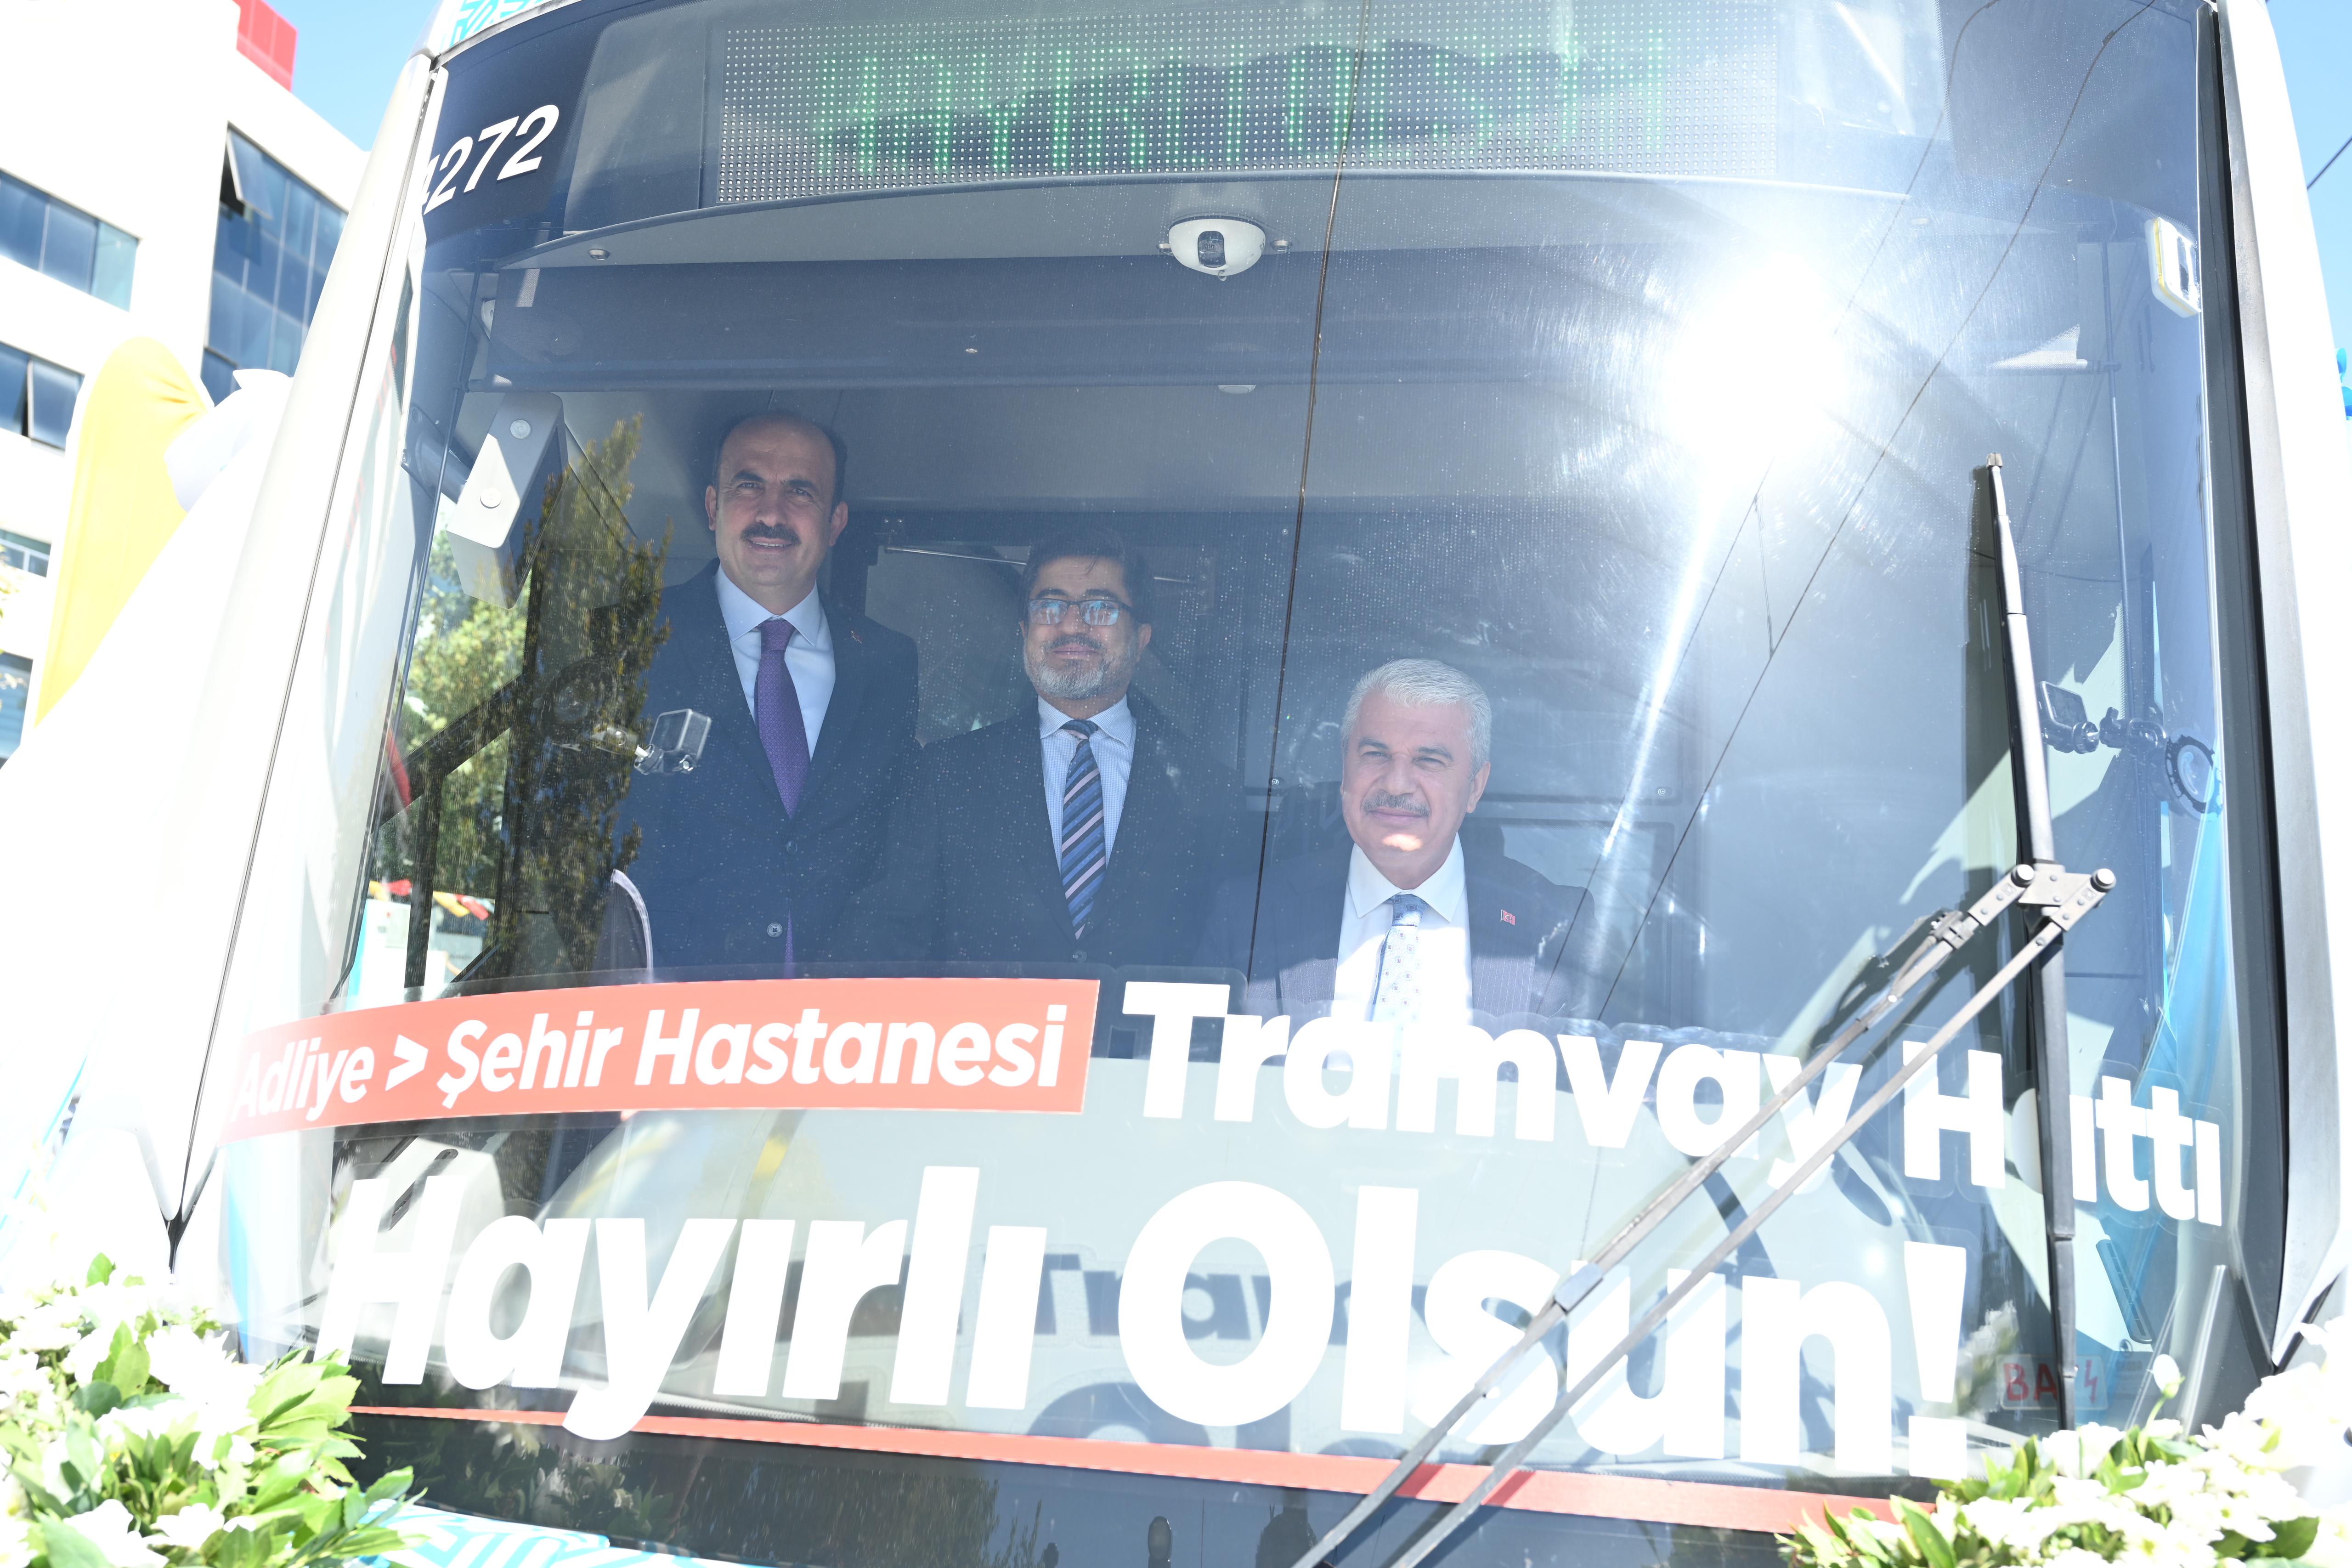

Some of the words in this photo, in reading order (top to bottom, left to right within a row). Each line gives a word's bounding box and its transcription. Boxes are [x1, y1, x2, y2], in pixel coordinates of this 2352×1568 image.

[814, 40, 1246, 175] HAYIRLI
[230, 1036, 375, 1122] Adliye
[437, 1010, 623, 1108] Şehir
[634, 1004, 1068, 1088] Hastanesi
[1122, 980, 1863, 1195] Tramvay
[313, 1165, 1047, 1440] Hayırlı
[1118, 1180, 1968, 1480] Olsun!
